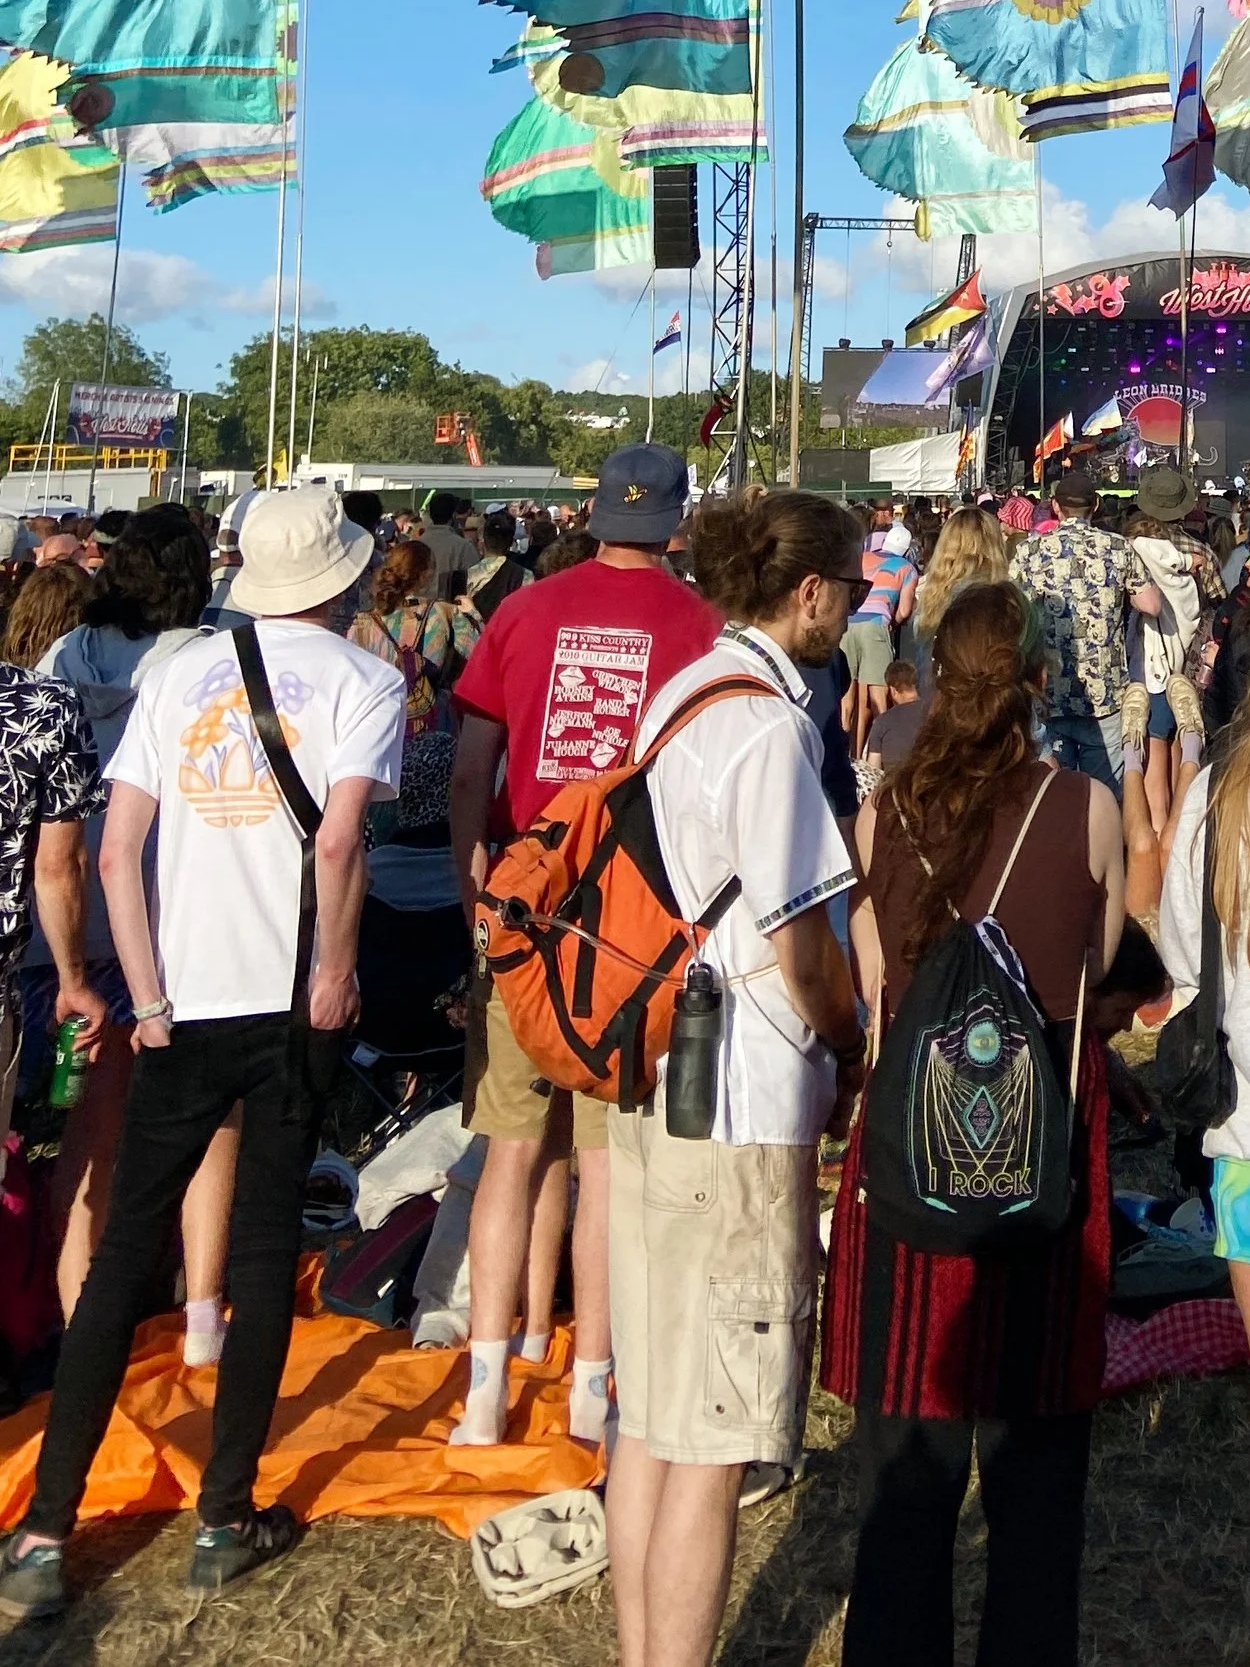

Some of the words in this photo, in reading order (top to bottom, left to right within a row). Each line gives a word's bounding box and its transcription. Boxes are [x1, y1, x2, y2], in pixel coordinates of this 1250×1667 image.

[1159, 281, 1228, 315] West
[1114, 384, 1149, 400] LEON
[579, 633, 602, 645] KISS
[602, 636, 649, 647] COUNTRY
[559, 651, 580, 660] 2010
[581, 652, 622, 663] GUITAR
[623, 655, 645, 666] JAM
[554, 685, 596, 695] RODNEY
[555, 693, 594, 703] ATKINS
[595, 698, 628, 708] RANDY
[603, 725, 622, 736] JOE
[592, 729, 630, 748] NICHOLS
[546, 740, 597, 750] JULIANNE
[553, 747, 588, 757] HOUGH
[928, 1167, 938, 1192] I
[949, 1167, 1033, 1198] ROCK
